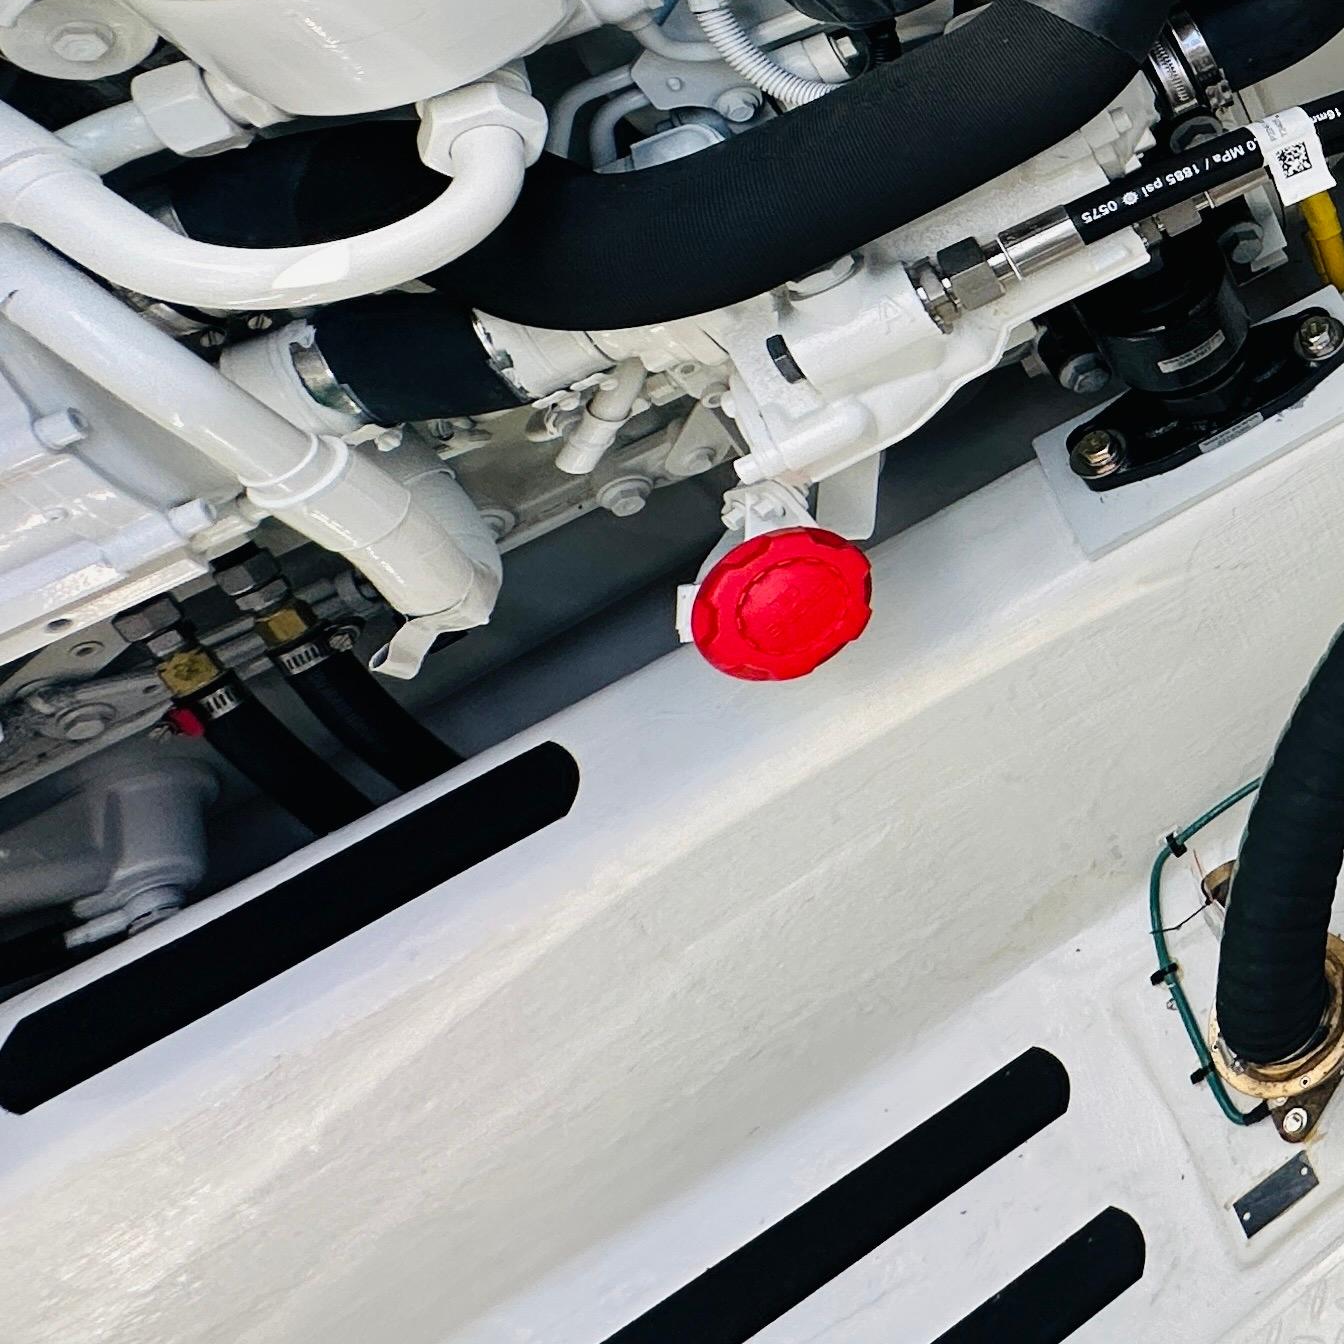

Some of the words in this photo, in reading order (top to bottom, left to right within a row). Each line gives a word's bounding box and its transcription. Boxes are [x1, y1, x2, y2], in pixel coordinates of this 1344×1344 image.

[1210, 143, 1246, 166] MPa
[1163, 162, 1201, 187] 1885
[1139, 176, 1164, 197] psi
[1080, 199, 1118, 223] 0575
